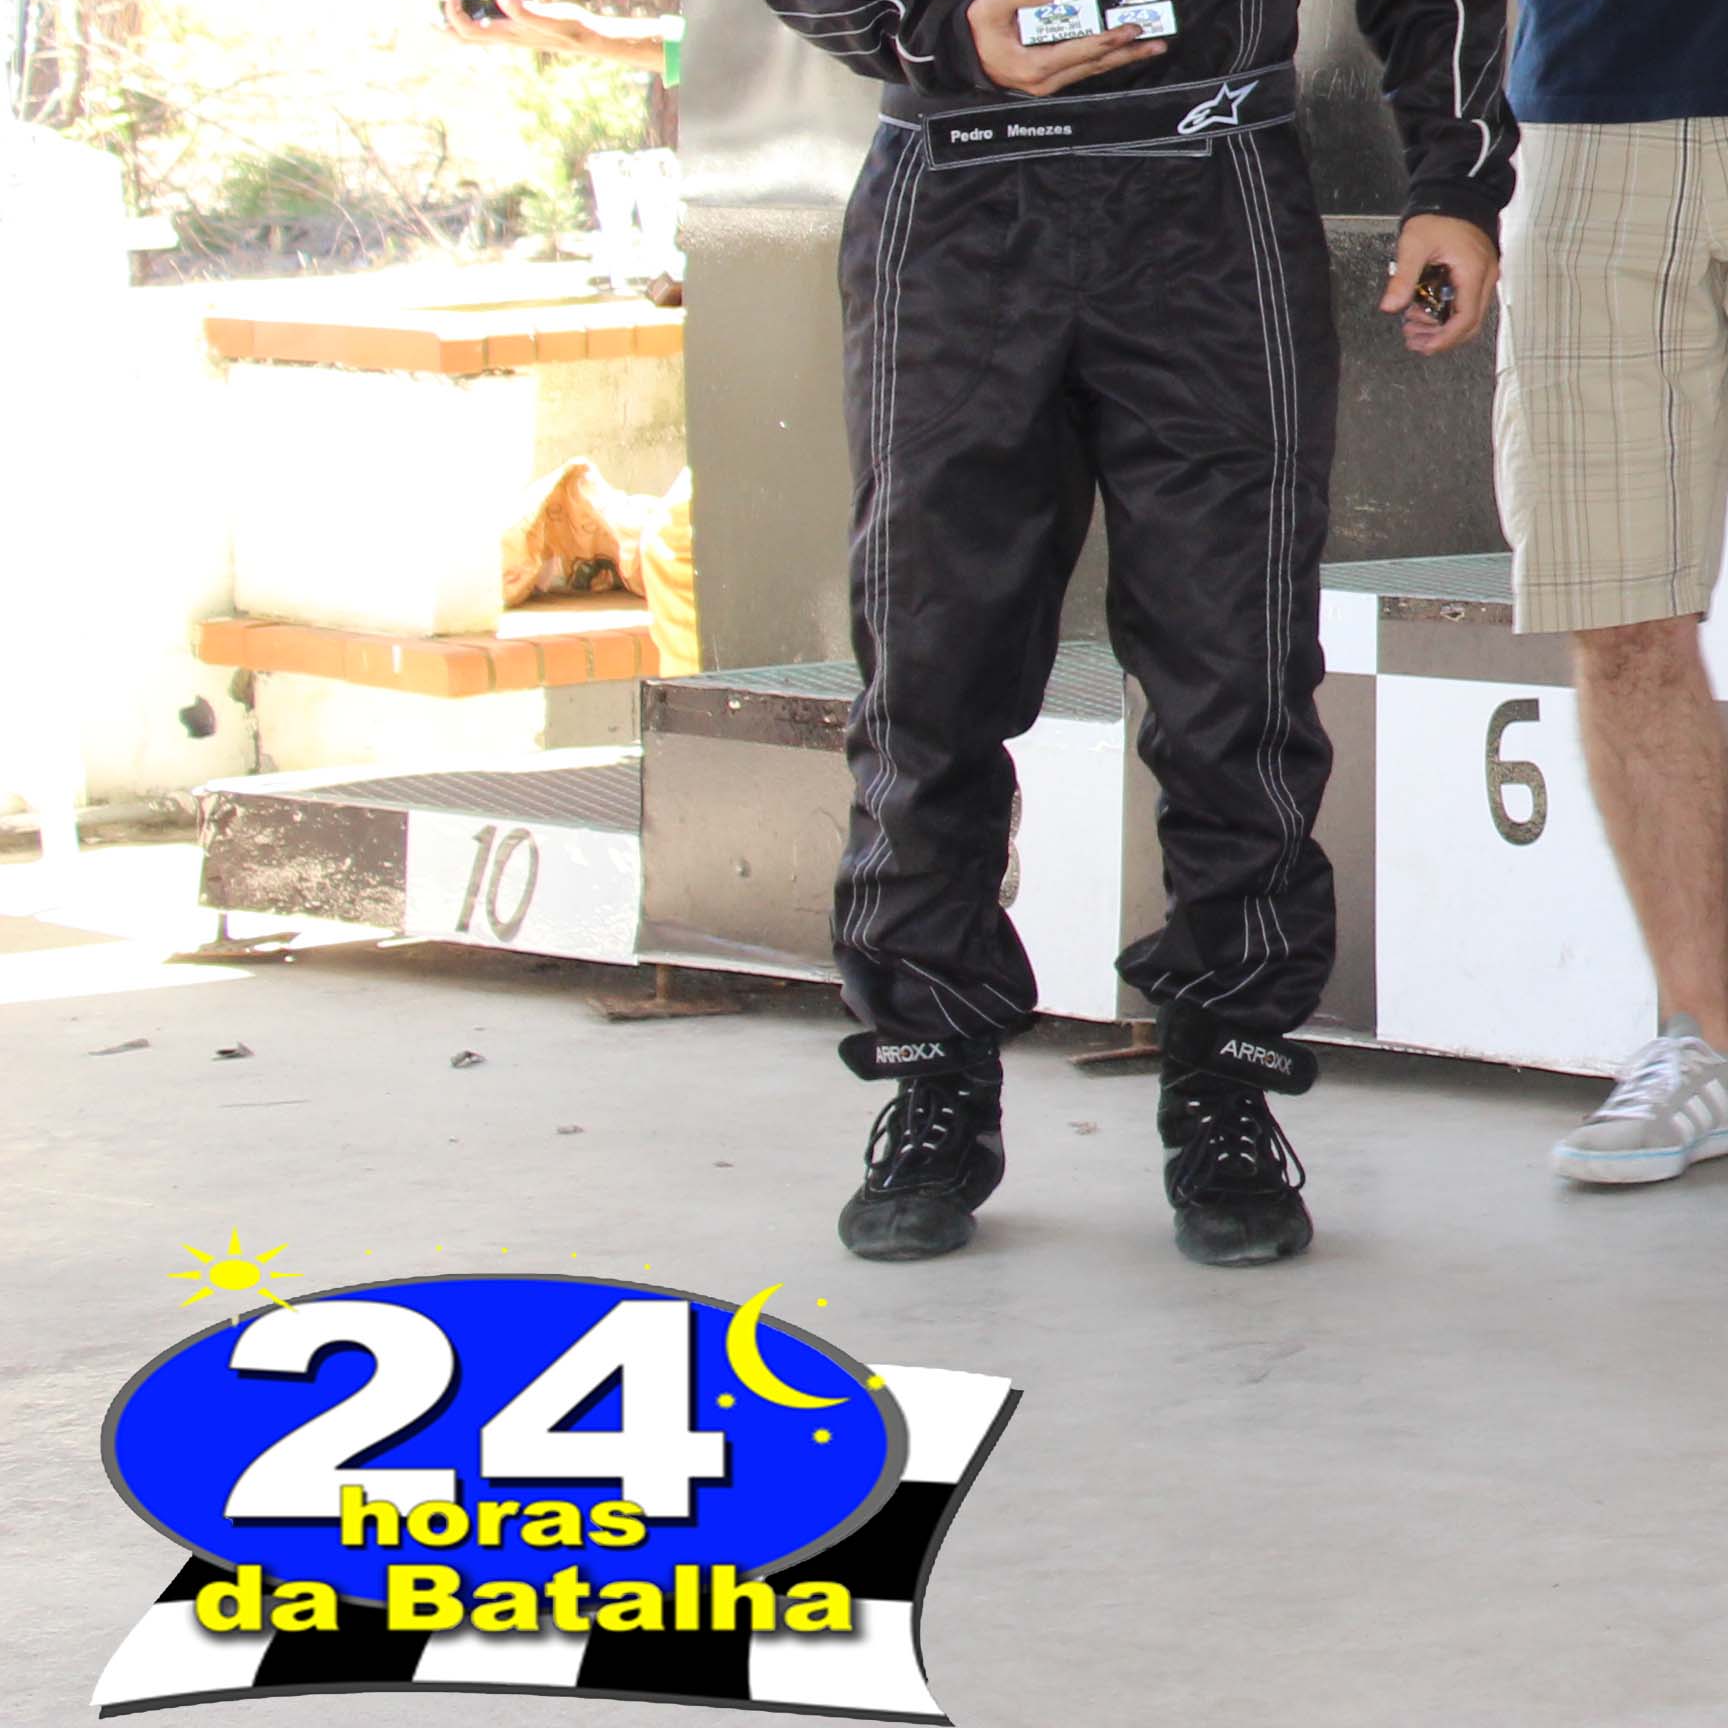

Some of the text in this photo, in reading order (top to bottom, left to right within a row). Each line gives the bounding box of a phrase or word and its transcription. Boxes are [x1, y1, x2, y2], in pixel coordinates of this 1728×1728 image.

[951, 123, 1072, 144] Pedro Menezes
[1485, 698, 1548, 846] 6
[456, 825, 539, 941] 10
[876, 1042, 945, 1064] ARROXX
[1220, 1039, 1293, 1076] ARROXX
